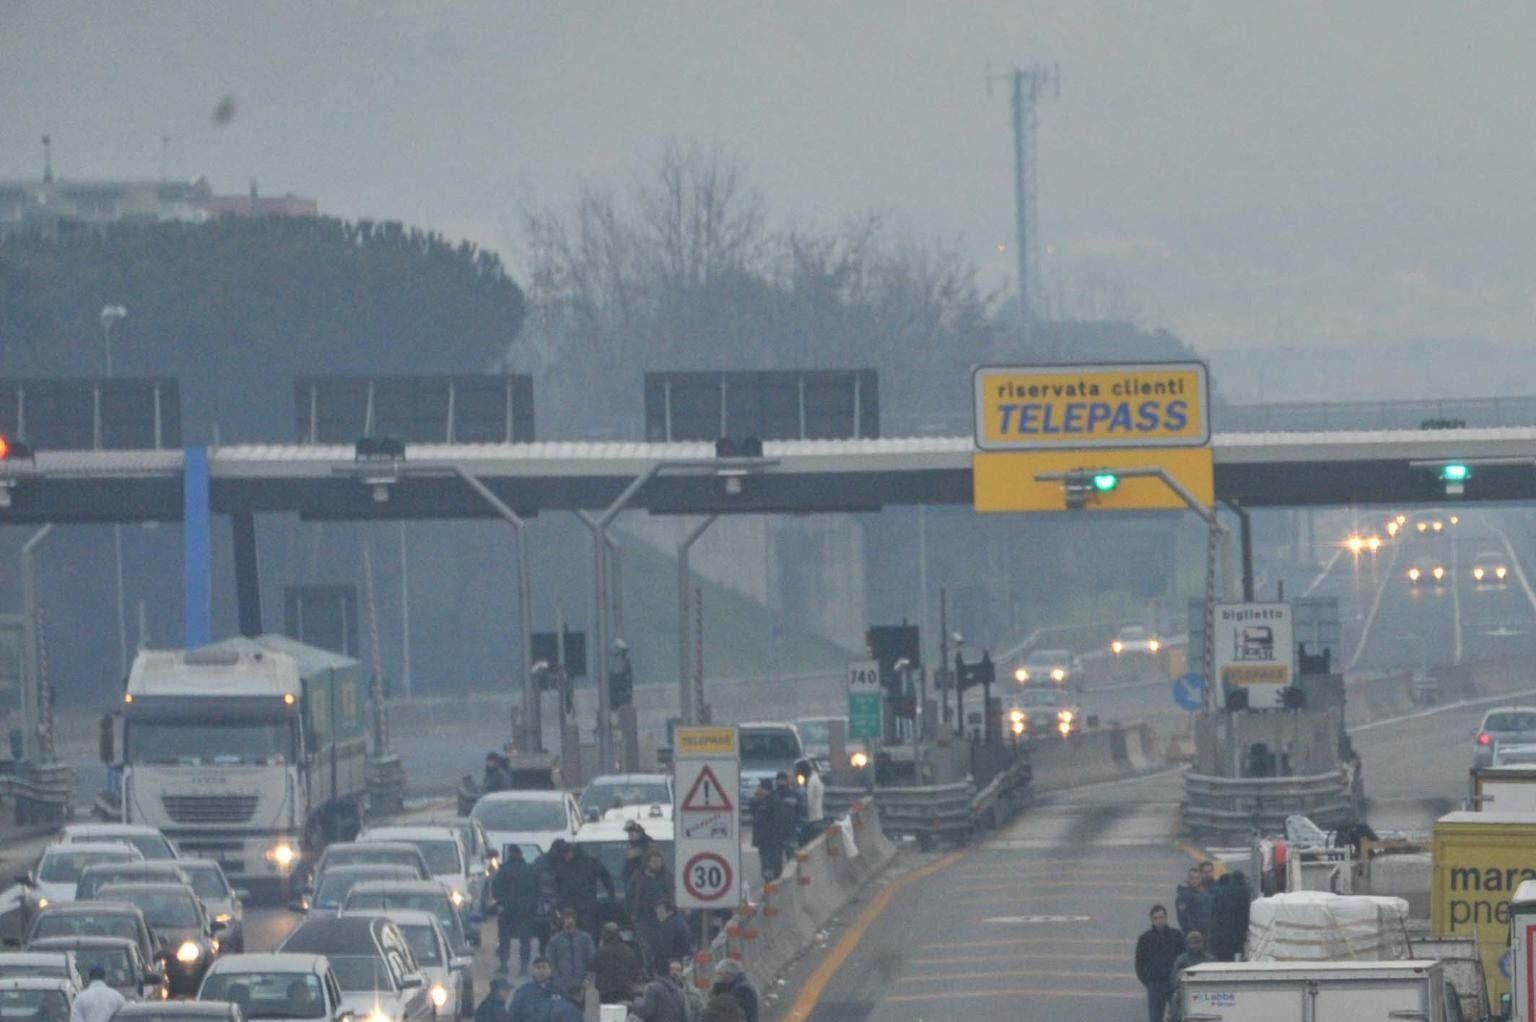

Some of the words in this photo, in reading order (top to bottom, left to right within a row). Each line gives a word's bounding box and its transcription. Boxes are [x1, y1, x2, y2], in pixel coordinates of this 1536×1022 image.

[998, 382, 1100, 398] riservata
[1111, 378, 1184, 397] clienti
[997, 401, 1188, 434] TELEPASS
[1222, 609, 1283, 621] biglietto
[851, 670, 877, 684] 740
[695, 865, 722, 889] 30
